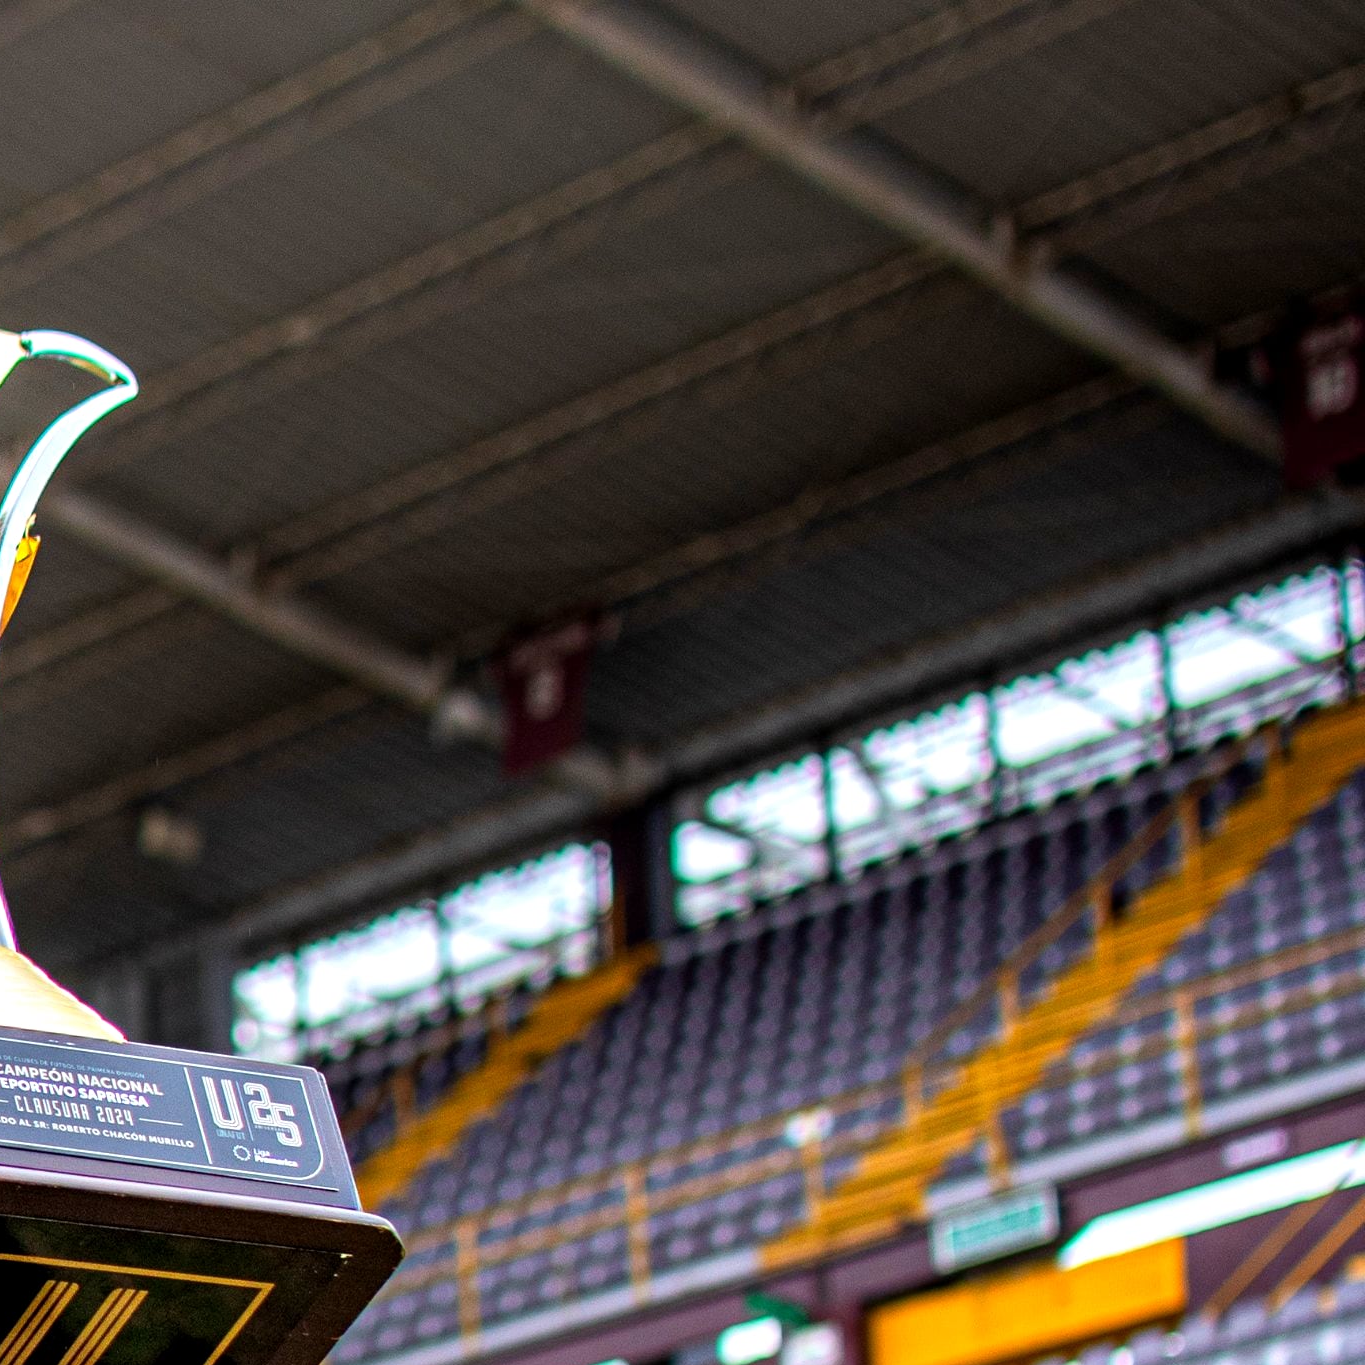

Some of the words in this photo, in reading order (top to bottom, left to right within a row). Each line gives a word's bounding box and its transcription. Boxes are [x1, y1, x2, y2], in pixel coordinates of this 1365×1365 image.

[77, 1073, 164, 1096] NACIONAL
[14, 1095, 90, 1121] CLAUSURA
[96, 1106, 134, 1126] 2024
[78, 1088, 150, 1108] SAPRISSA
[19, 1118, 32, 1128] AL
[52, 1122, 101, 1136] ROBERTO
[102, 1127, 146, 1142] CHACÓN
[148, 1135, 195, 1148] MURILLO
